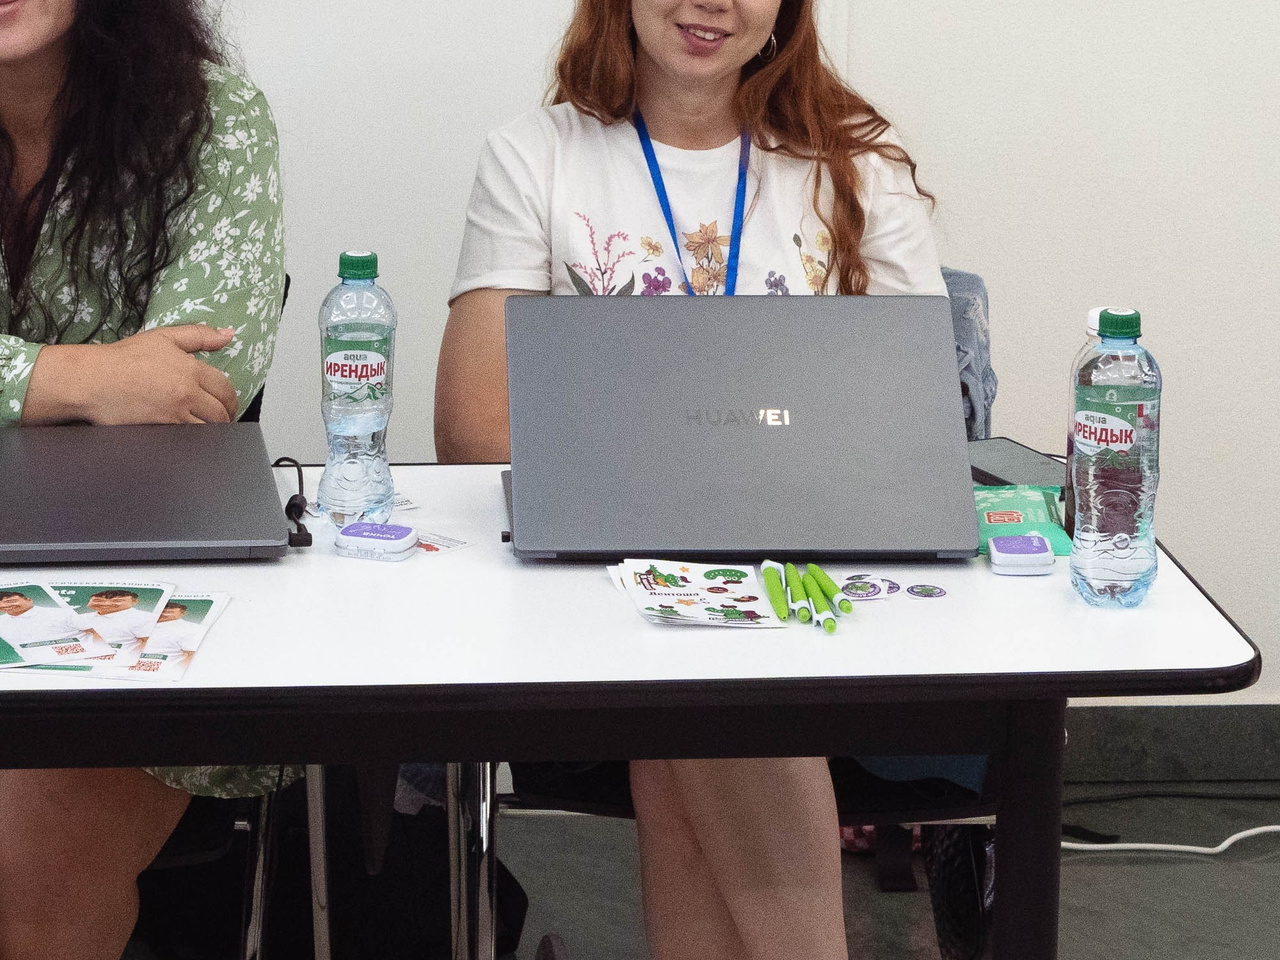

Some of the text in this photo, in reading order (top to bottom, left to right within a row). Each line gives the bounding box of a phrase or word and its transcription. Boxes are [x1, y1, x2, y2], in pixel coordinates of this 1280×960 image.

[344, 353, 367, 362] aqua
[326, 361, 385, 381] ИРЕНДЫК
[685, 407, 790, 426] HUAWEI
